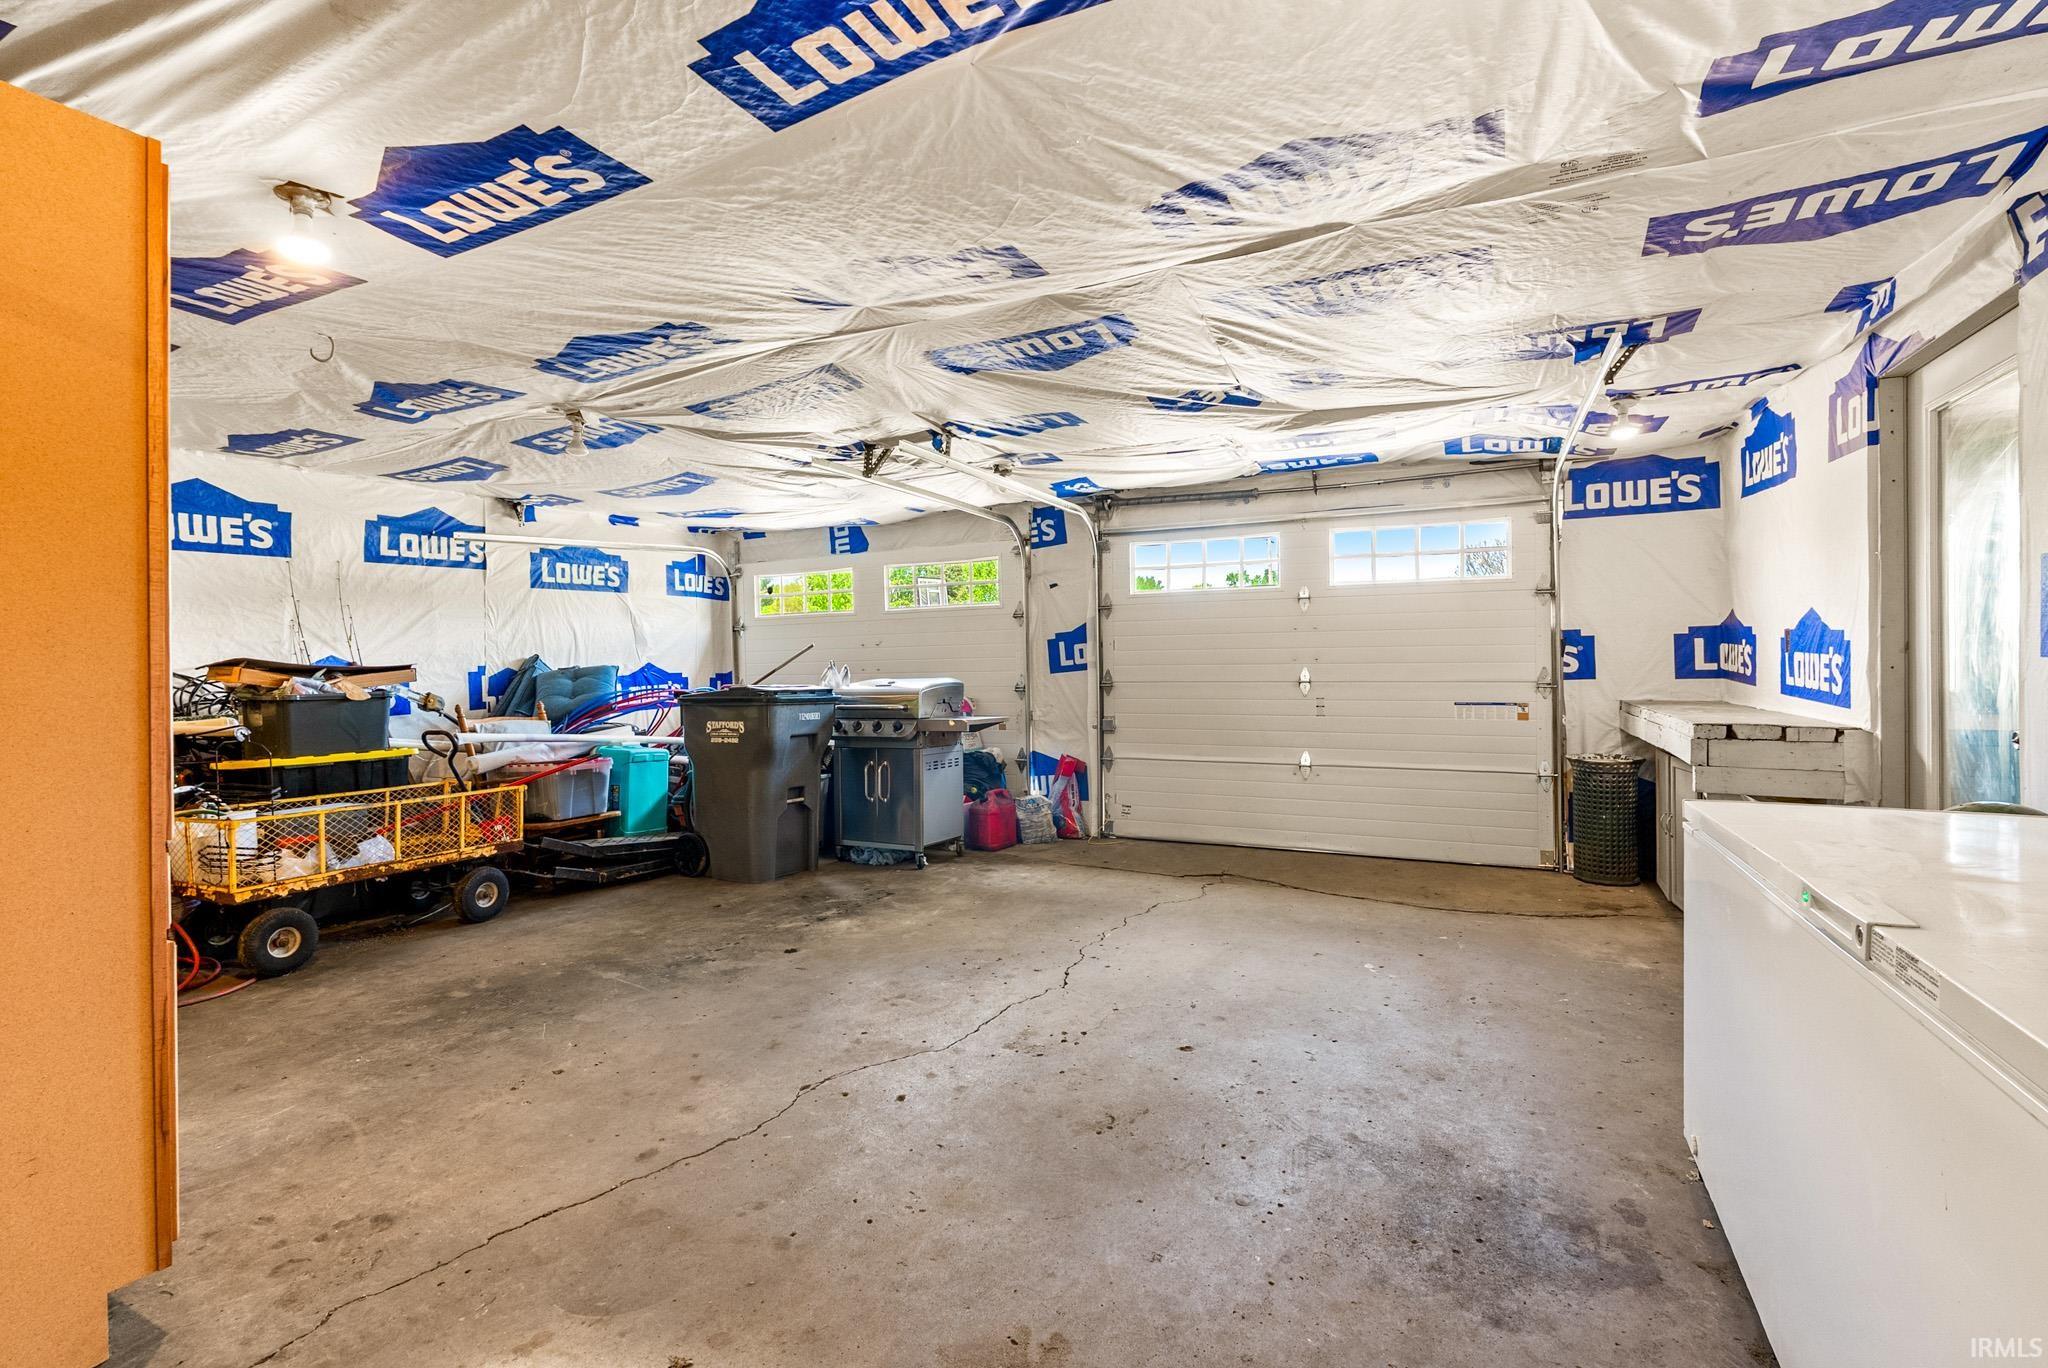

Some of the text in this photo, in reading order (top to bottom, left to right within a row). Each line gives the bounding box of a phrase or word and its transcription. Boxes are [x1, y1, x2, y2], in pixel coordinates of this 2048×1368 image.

[380, 152, 607, 244] LOWE'S
[1684, 135, 2034, 243] LOWE'S
[171, 263, 333, 313] LOWE'S
[557, 332, 716, 379] LOWE'S
[373, 386, 502, 418] LOWE'S
[235, 433, 343, 457] LOWE'S
[1745, 433, 1788, 487] LOWE'S
[396, 461, 493, 482] LOWE'S
[616, 476, 706, 497] LOWE'S
[1564, 470, 1701, 512] LOWE'S
[173, 513, 274, 550] WE'S
[541, 556, 620, 588] LOWE'S
[1694, 638, 1752, 676] LOWE'S
[1785, 646, 1842, 695] LOWE'S
[706, 721, 744, 733] STAFFORD'S
